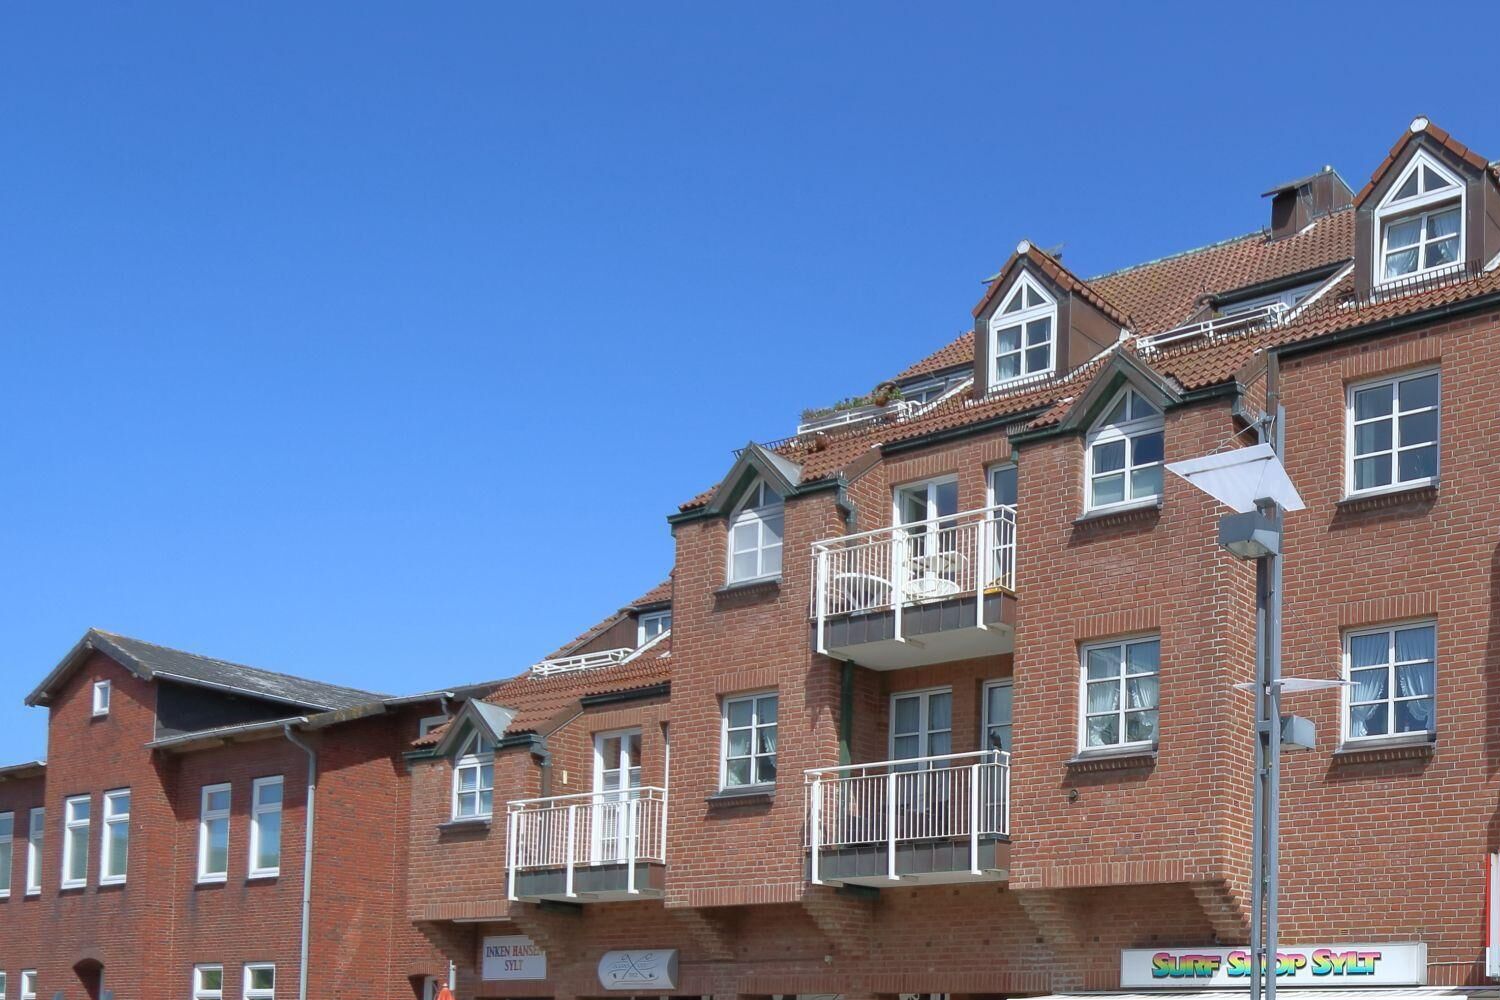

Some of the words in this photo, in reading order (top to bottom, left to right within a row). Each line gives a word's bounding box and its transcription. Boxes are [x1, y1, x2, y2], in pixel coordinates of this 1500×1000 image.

[486, 945, 510, 958] INKEN
[504, 959, 525, 971] SYLT
[1151, 952, 1222, 979] SURF
[1311, 948, 1382, 977] SYLT
